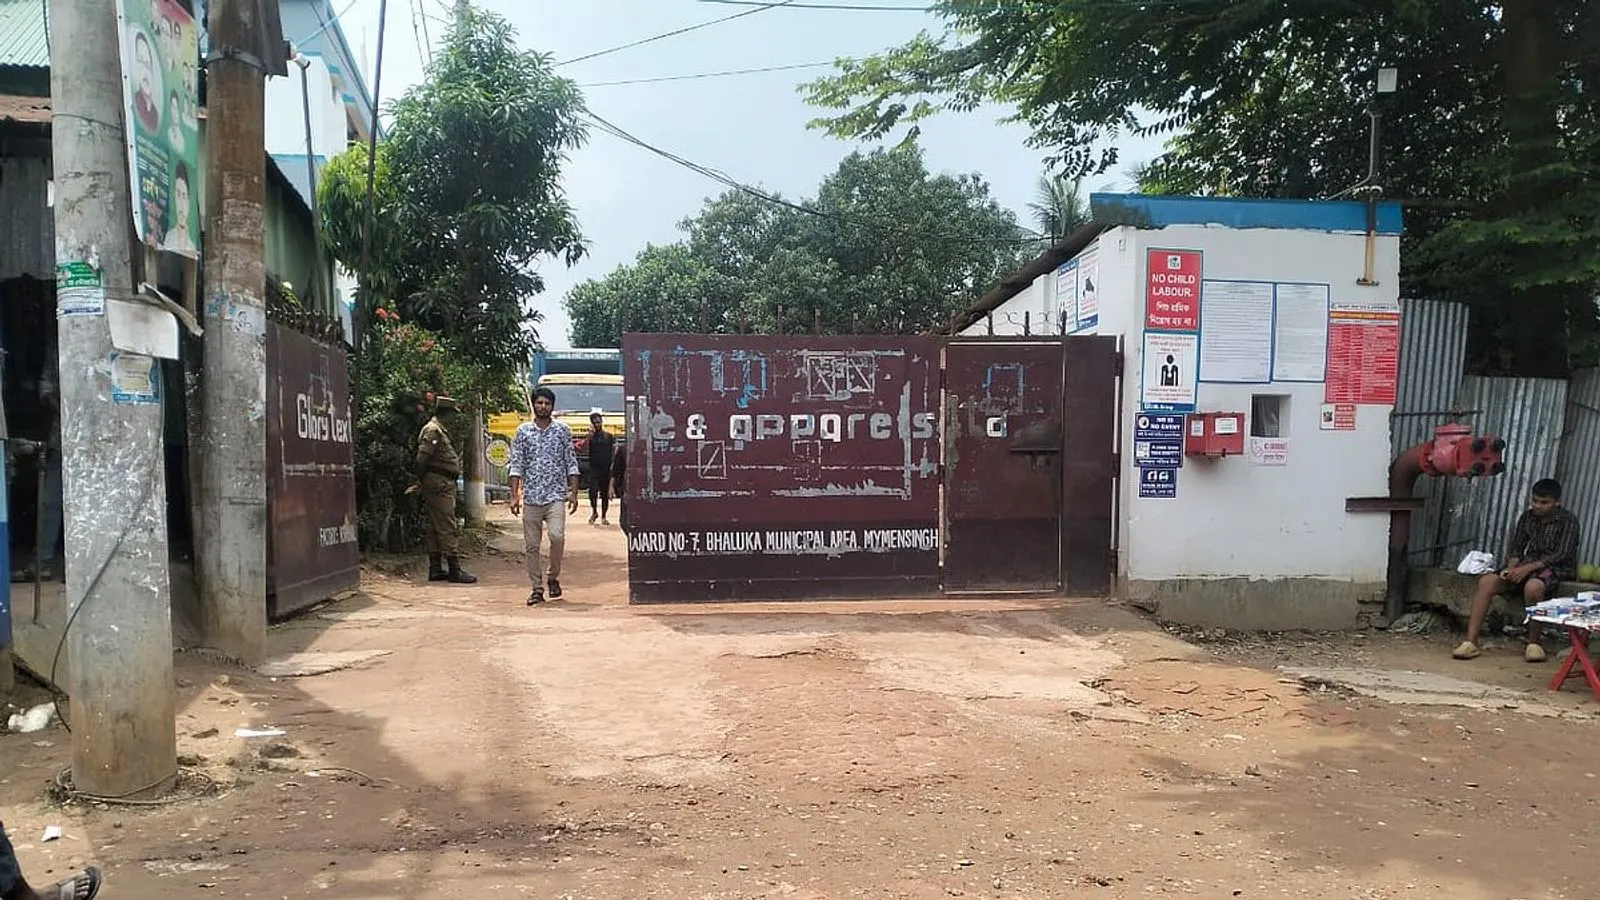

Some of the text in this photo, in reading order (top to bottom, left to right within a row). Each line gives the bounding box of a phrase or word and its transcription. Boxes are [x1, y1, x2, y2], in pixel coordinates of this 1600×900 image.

[1152, 274, 1196, 284] NO CHILD
[297, 393, 329, 441] Glory
[686, 413, 708, 440] &
[629, 531, 666, 552] WARD
[706, 531, 762, 552] BHALUKA
[765, 530, 825, 550] MUNICIPAL
[863, 529, 938, 549] MYMENSINGH
